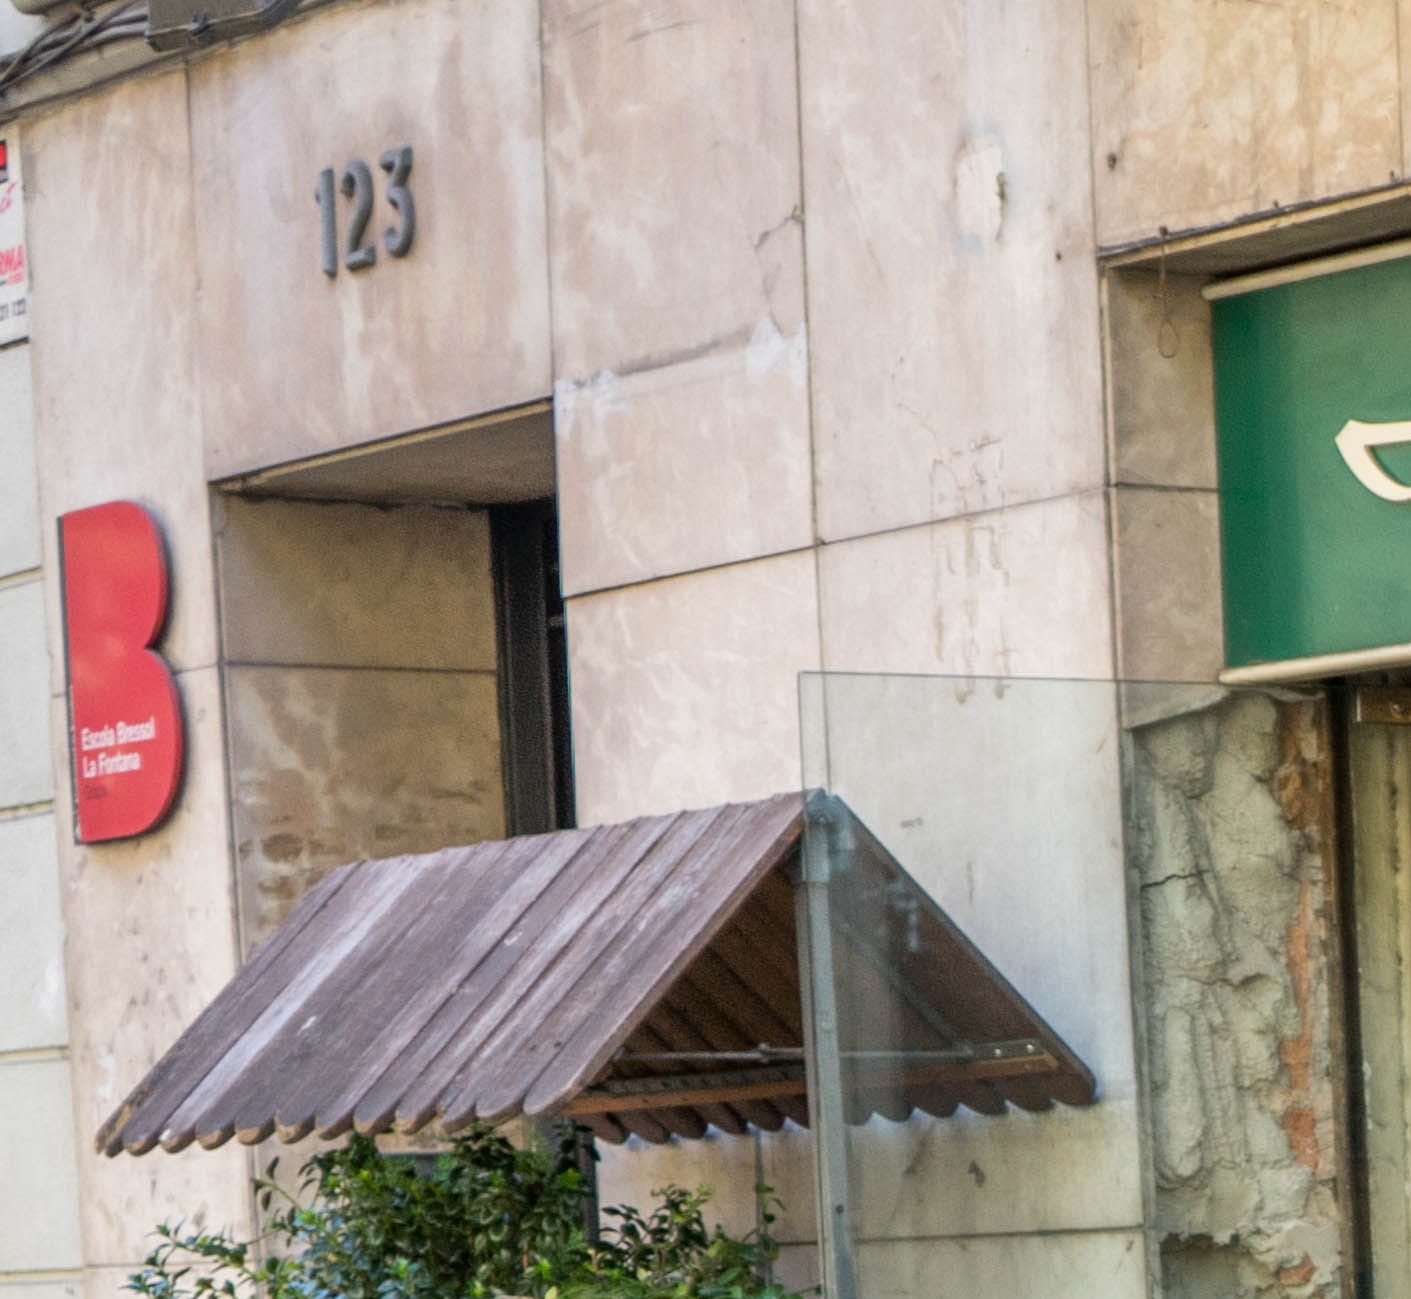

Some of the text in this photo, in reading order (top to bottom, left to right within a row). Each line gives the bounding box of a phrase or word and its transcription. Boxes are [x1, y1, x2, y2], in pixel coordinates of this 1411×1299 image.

[314, 146, 417, 277] 123
[81, 715, 156, 751] Escola Bressol
[82, 755, 97, 778] La
